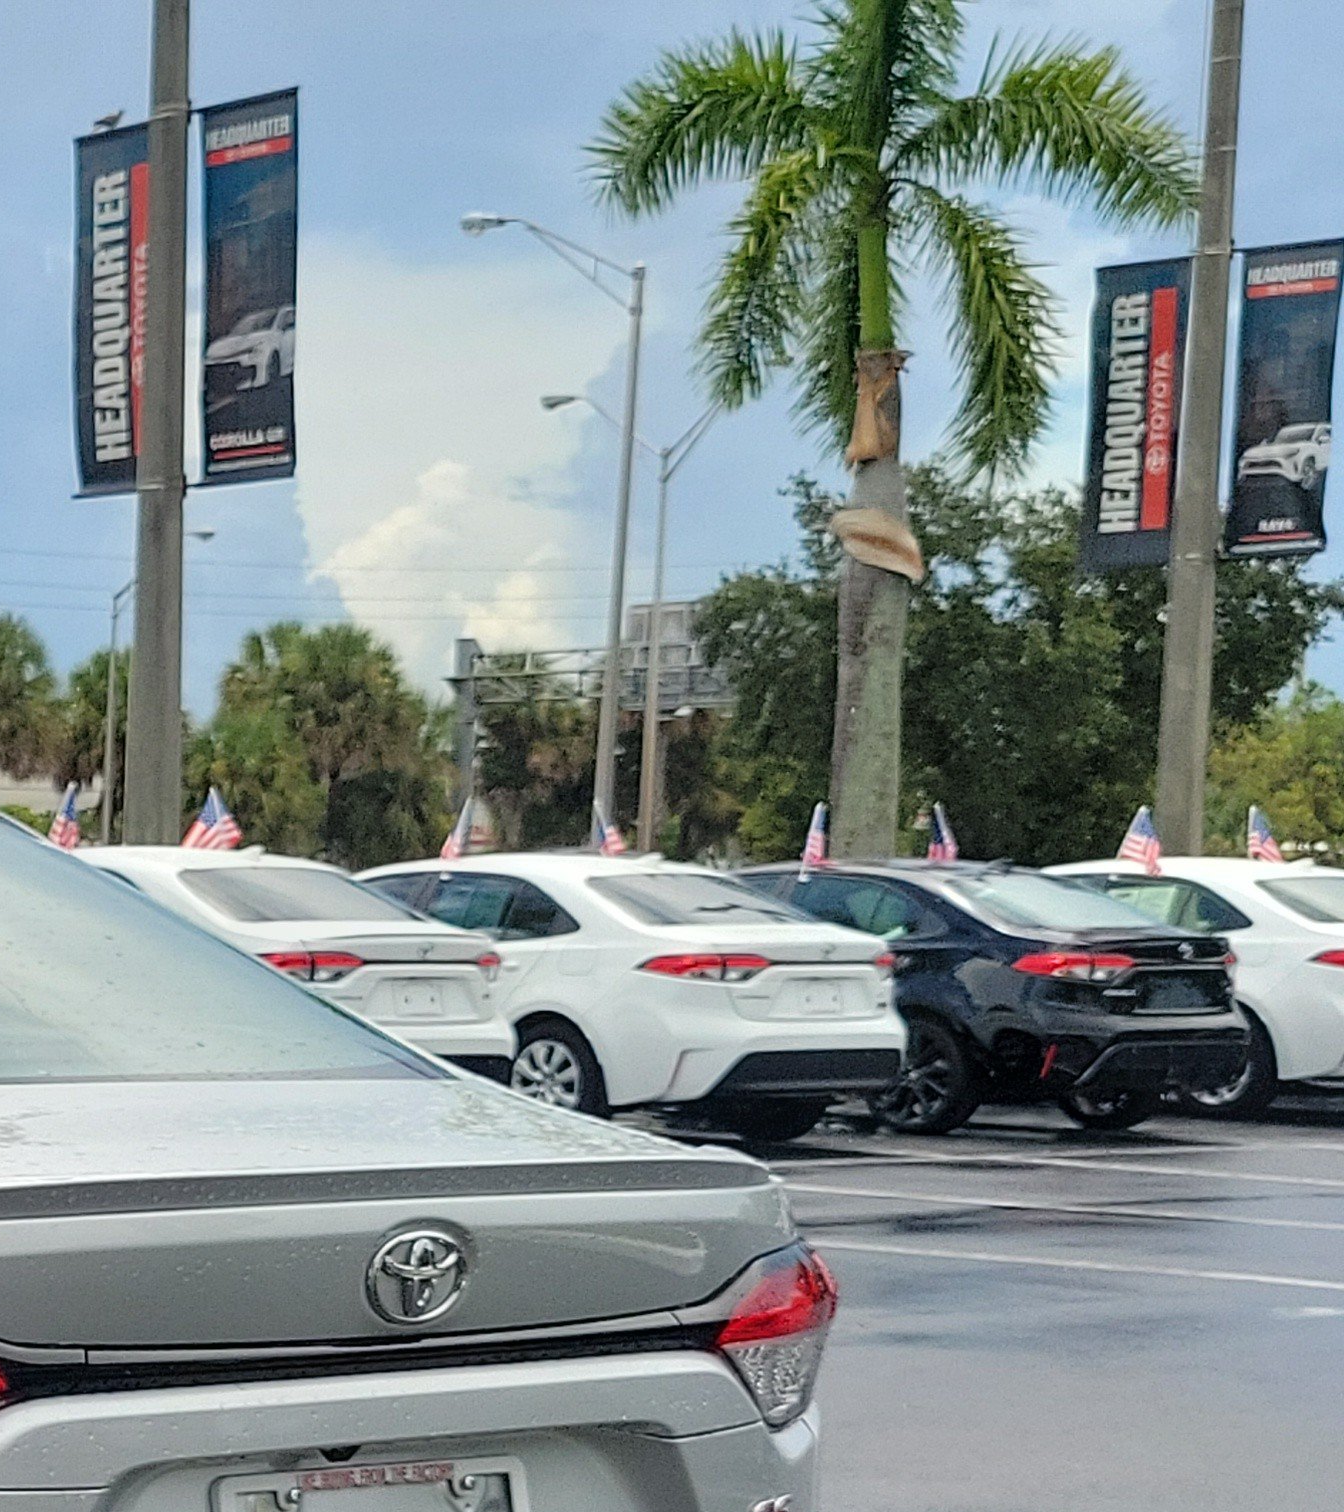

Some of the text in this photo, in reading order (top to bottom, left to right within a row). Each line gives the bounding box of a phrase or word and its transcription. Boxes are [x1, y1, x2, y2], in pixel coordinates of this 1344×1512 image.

[93, 169, 133, 463] HEADQUARTER
[1098, 292, 1149, 533] HEADQUARTER
[1150, 350, 1172, 441] TOYOTA
